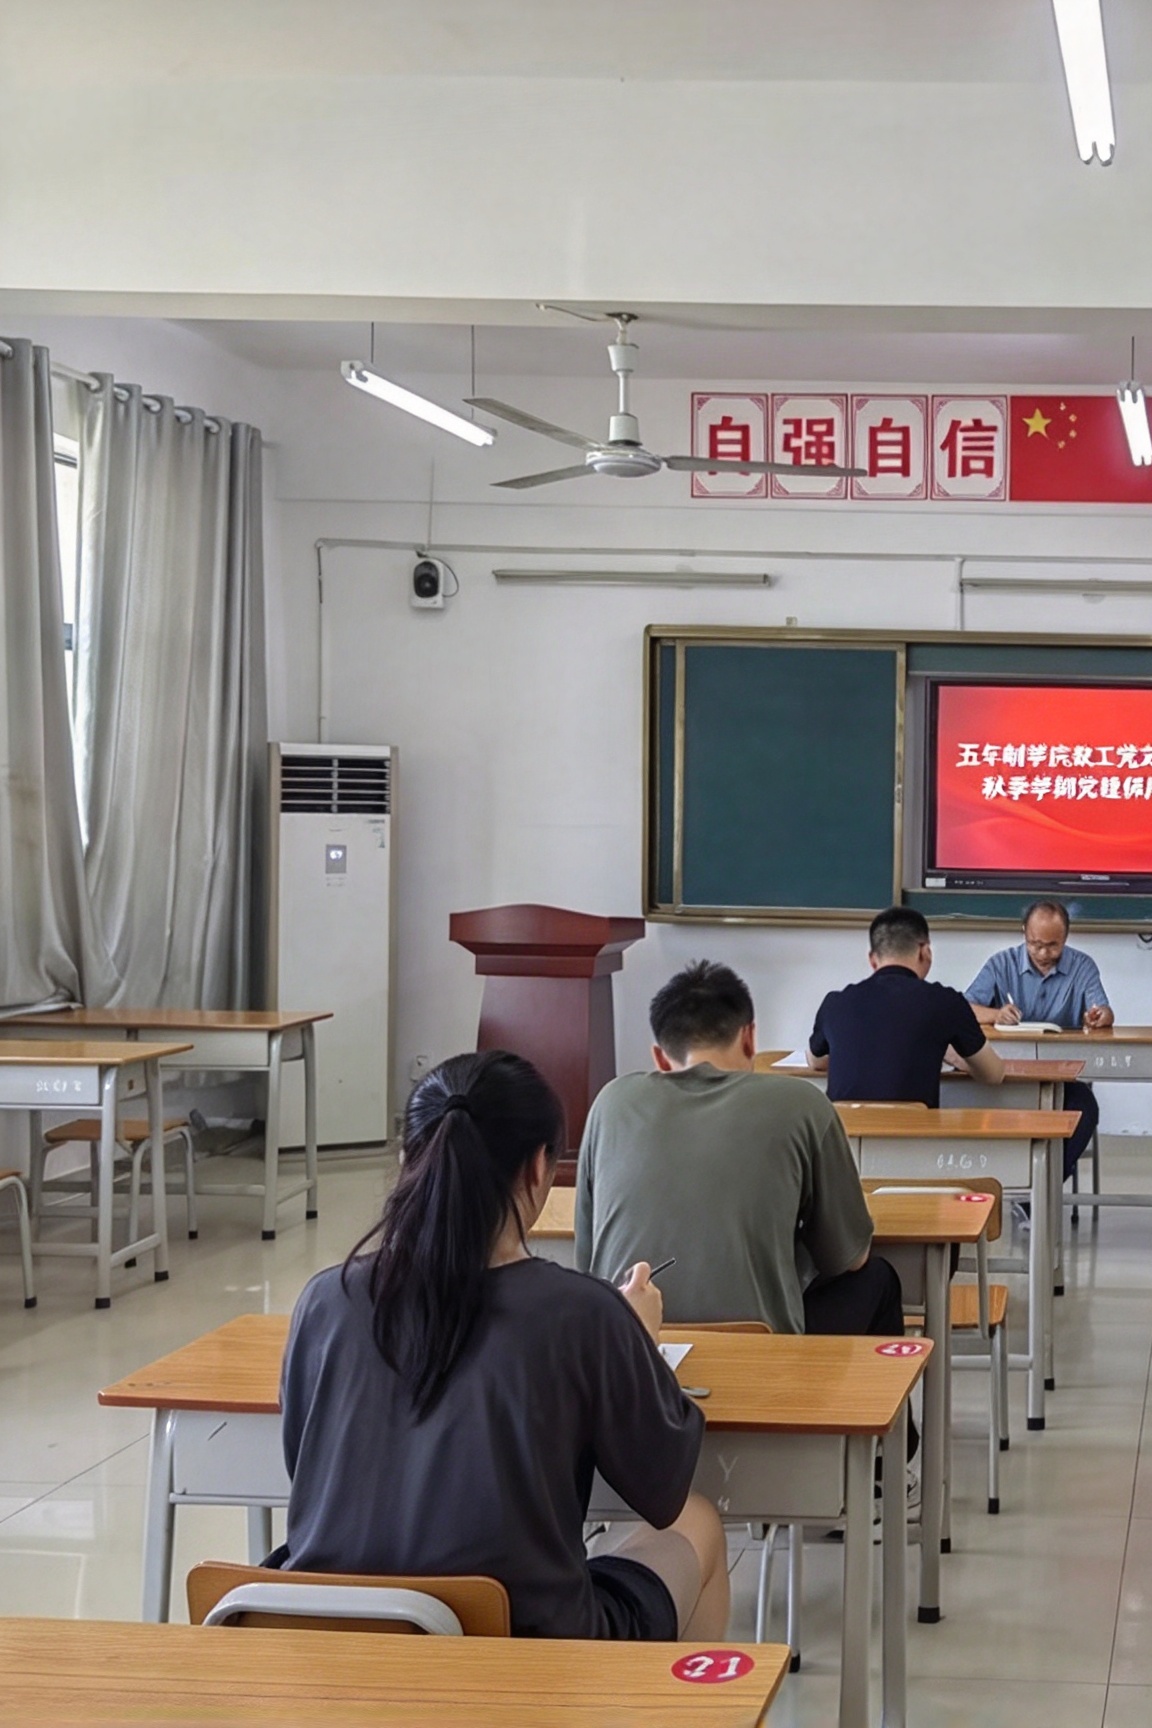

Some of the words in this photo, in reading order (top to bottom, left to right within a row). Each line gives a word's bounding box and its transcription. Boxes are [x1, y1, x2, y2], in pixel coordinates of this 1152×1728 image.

[708, 415, 998, 478] 自强自信
[683, 1656, 741, 1678] 21
